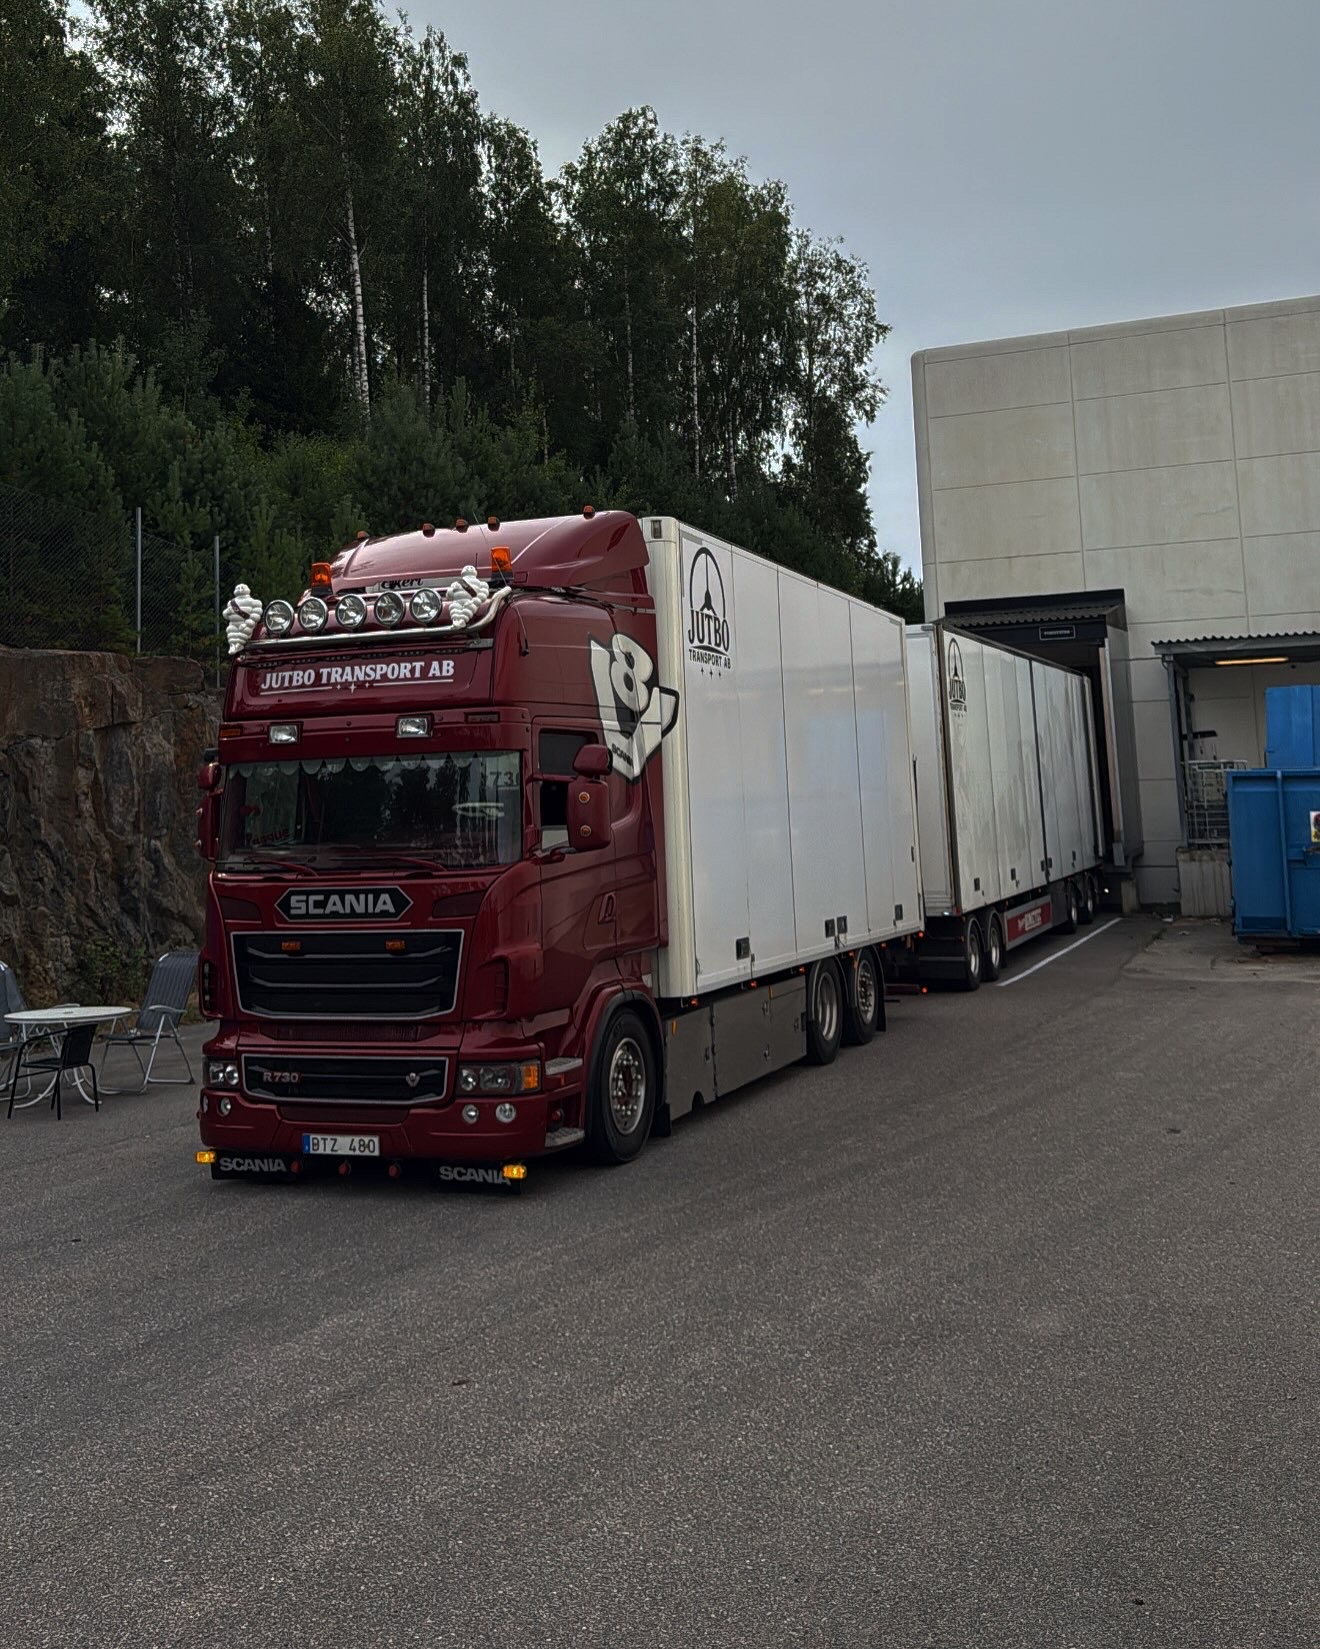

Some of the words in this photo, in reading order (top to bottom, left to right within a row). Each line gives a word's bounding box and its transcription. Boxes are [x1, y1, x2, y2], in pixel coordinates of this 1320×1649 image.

[688, 609, 730, 652] JUTBO
[688, 648, 722, 667] TRANSPORT
[723, 658, 731, 669] AB
[261, 669, 315, 689] JUTBO
[320, 661, 425, 683] TRANSPORT
[428, 660, 455, 677] AB
[290, 893, 396, 914] SCANIA
[263, 1072, 299, 1083] R730
[311, 1137, 338, 1152] BTZ
[348, 1138, 376, 1153] 480
[219, 1157, 287, 1172] SCANIA
